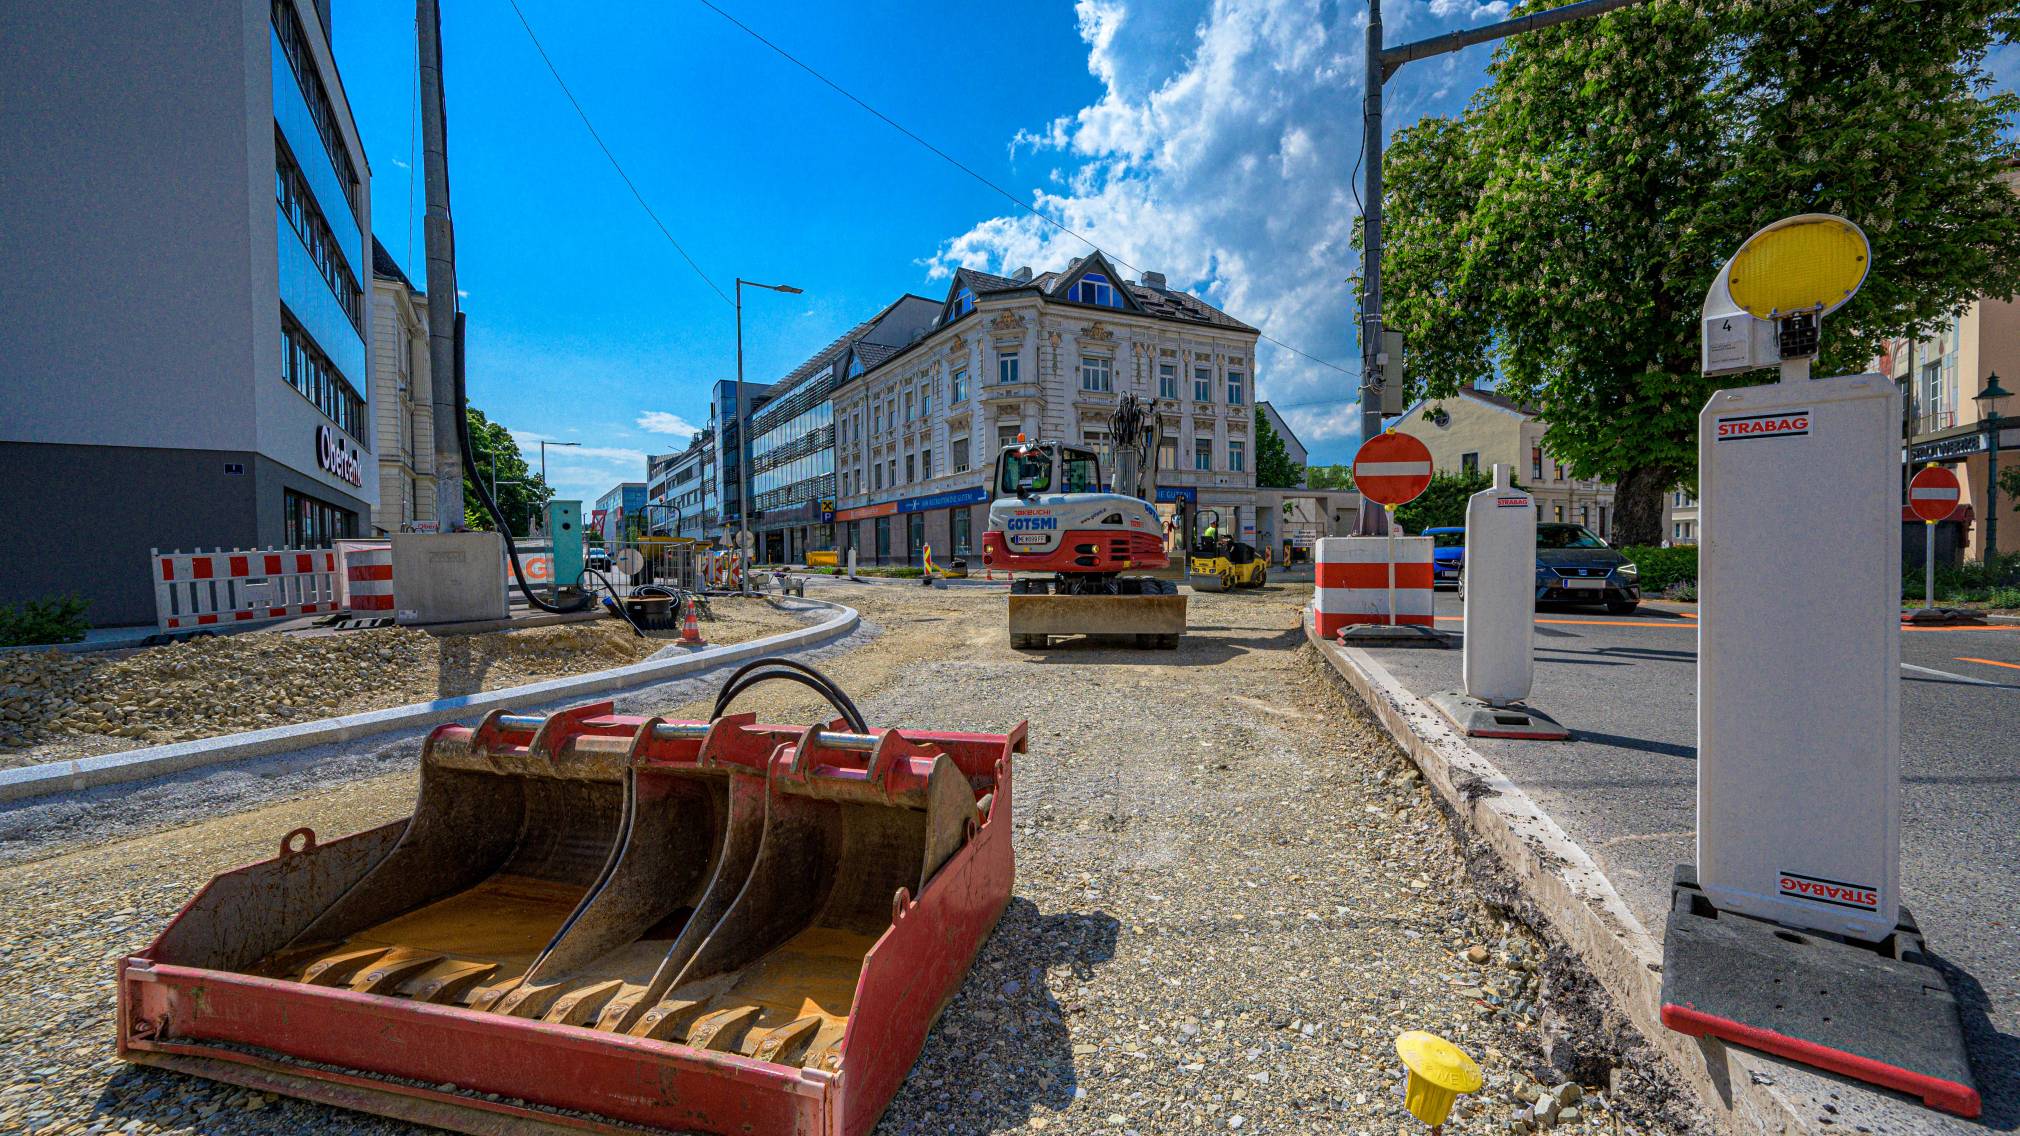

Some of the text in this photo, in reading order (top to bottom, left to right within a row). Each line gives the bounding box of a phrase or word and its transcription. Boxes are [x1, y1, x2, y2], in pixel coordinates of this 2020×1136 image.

[1722, 319, 1732, 331] 4
[1718, 417, 1809, 436] STRABAG
[316, 425, 362, 488] Oberbank
[824, 512, 832, 521] P
[1007, 517, 1058, 531] GOTSMI
[1779, 877, 1878, 906] STRABAG
